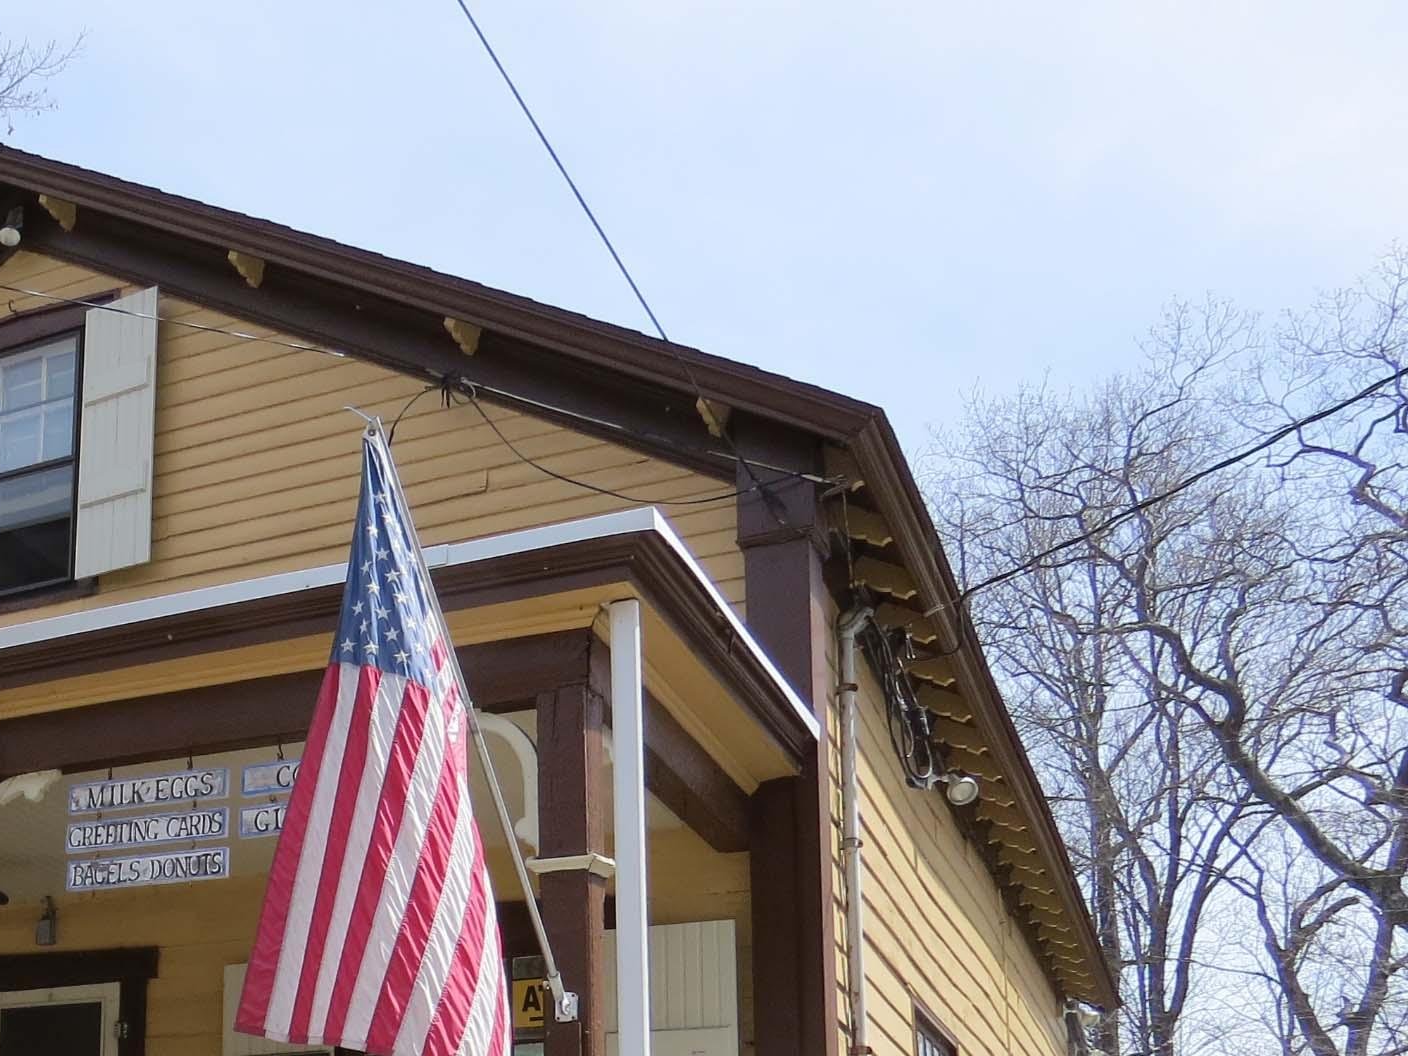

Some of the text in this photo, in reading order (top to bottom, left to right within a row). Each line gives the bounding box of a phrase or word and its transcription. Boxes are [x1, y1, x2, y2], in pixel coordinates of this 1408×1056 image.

[155, 772, 214, 799] EGGS
[69, 811, 222, 848] GREETING CARDS
[72, 852, 222, 887] BAGELS DONUTS
